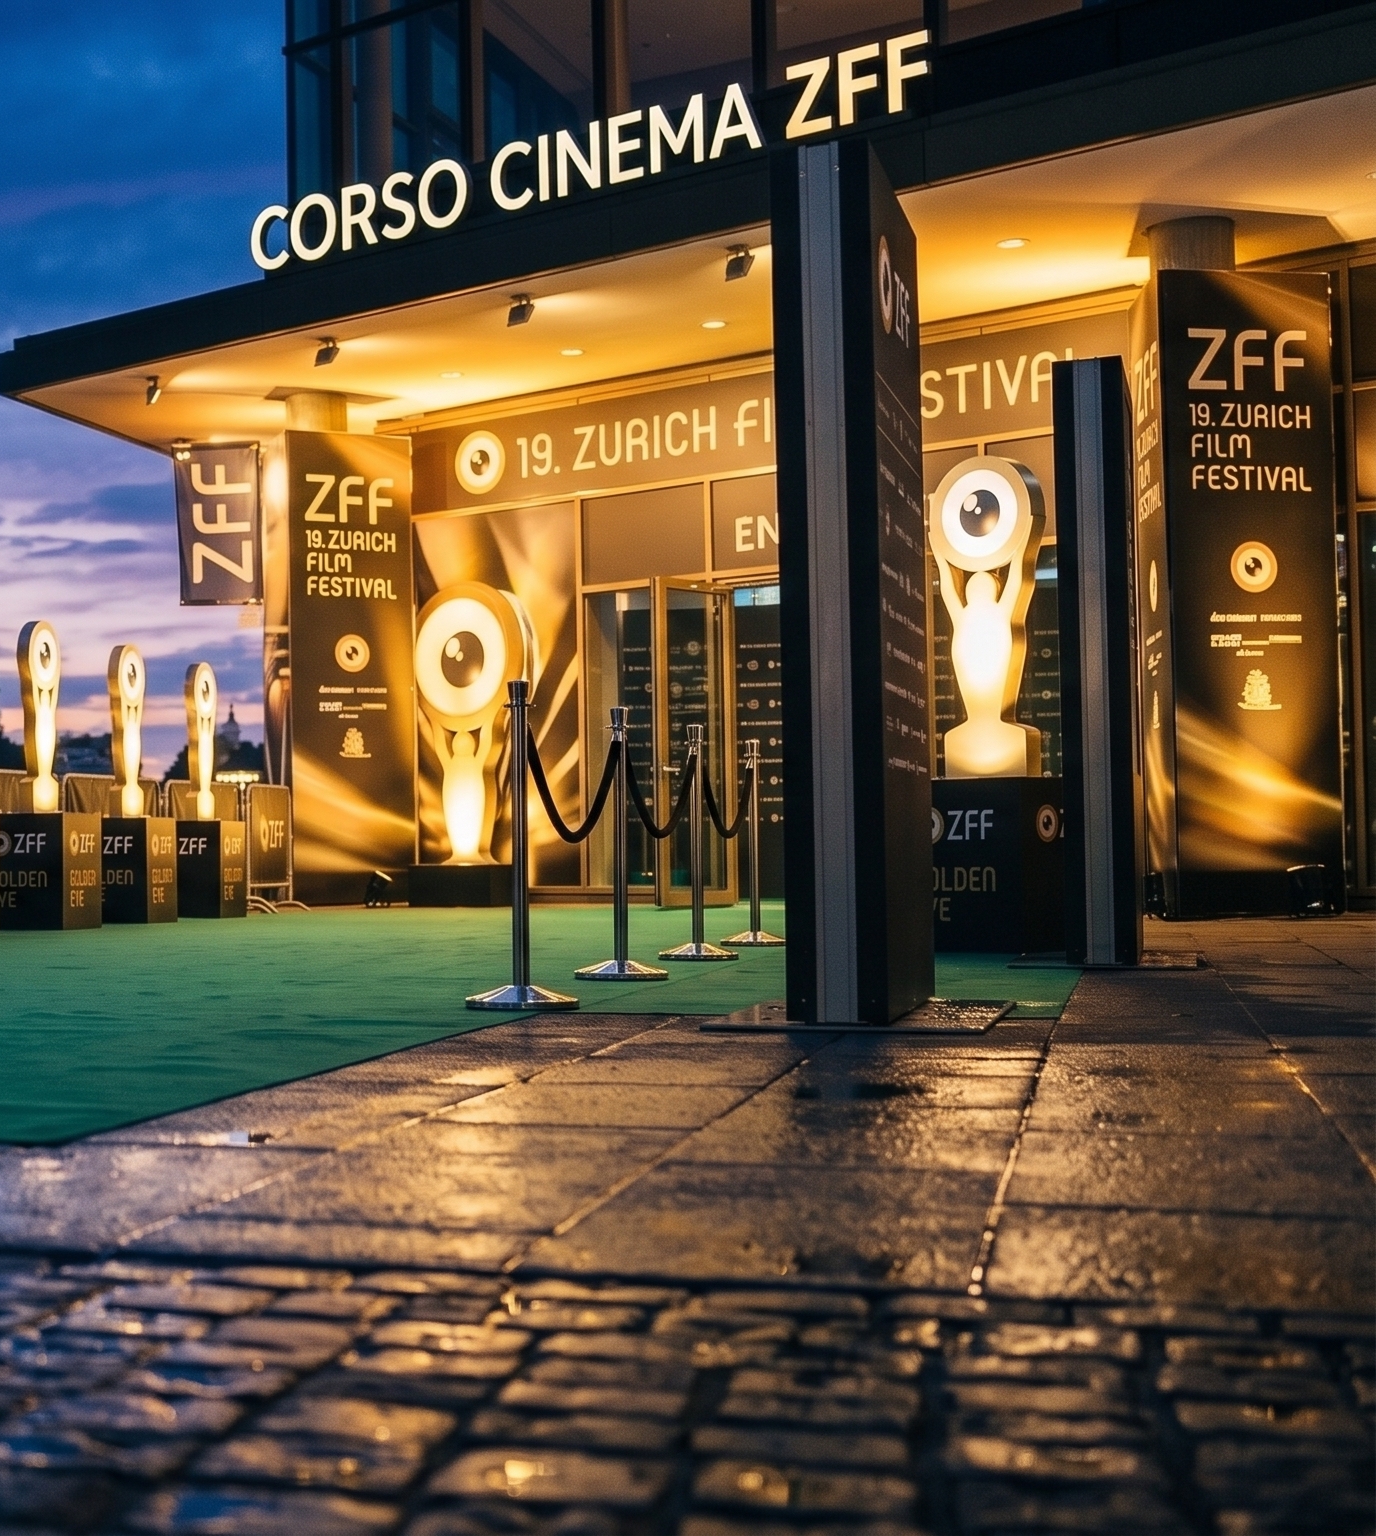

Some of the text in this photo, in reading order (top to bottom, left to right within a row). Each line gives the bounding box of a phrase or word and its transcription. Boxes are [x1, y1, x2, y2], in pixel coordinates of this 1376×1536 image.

[250, 29, 930, 270] CORSO CINEMA ZFF
[1187, 328, 1307, 392] ZFF
[1134, 341, 1158, 427] ZFF
[1188, 403, 1311, 429] 19. ZURICH
[516, 432, 561, 479] 19.
[572, 405, 717, 472] ZURICH
[733, 396, 771, 447] FI
[1191, 433, 1251, 459] FILM
[1192, 464, 1312, 492] FESTIVAL
[304, 473, 394, 525] ZFF
[190, 463, 254, 584] ZFF
[306, 529, 397, 553] 19. ZURICH
[306, 552, 352, 573] FILM
[307, 576, 397, 600] FESTIVAL
[269, 820, 285, 848] ZFF
[947, 809, 994, 841] ZFF
[13, 833, 46, 854] ZFF
[103, 836, 134, 855] ZFF
[179, 837, 207, 855] ZFF
[0, 870, 48, 888] OLDEN
